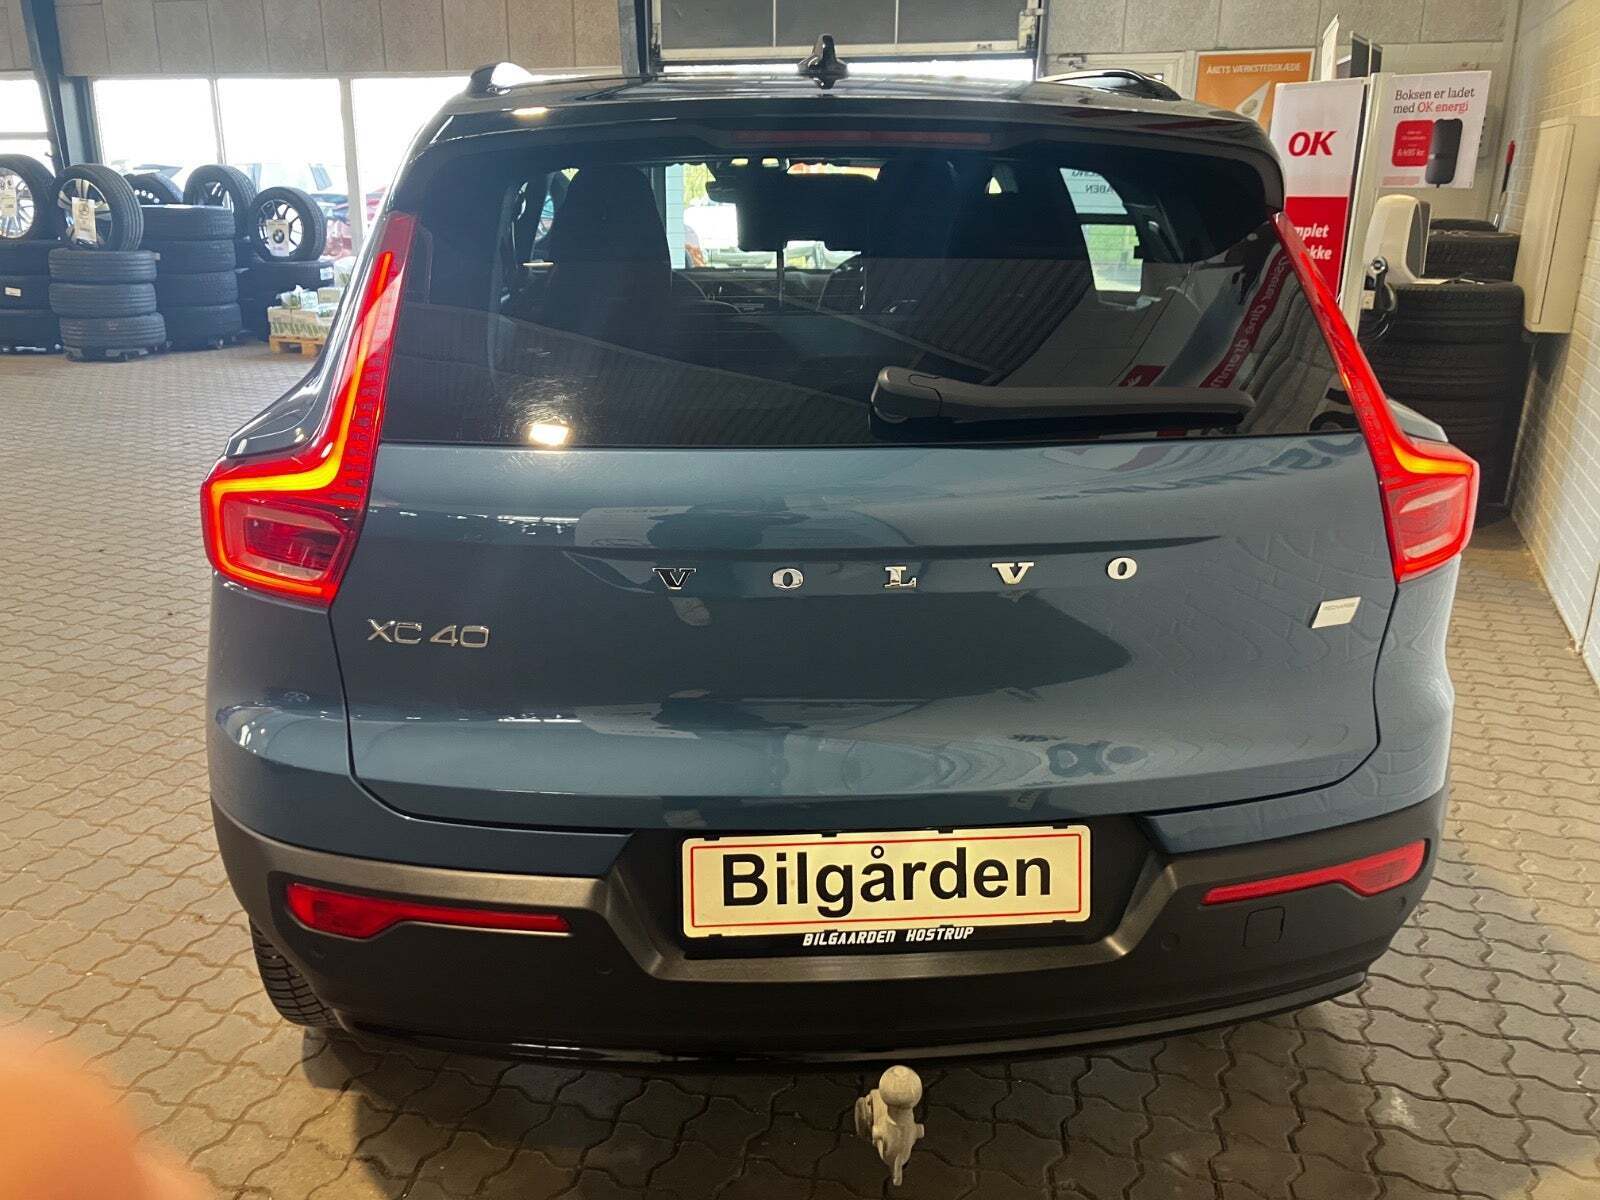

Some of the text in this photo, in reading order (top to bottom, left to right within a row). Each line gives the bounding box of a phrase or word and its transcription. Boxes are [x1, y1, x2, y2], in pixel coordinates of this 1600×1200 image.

[1394, 86, 1476, 101] Boksen er ladet
[1393, 100, 1469, 114] med OK energi
[1288, 130, 1338, 157] OK
[1294, 222, 1330, 241] mplet
[652, 557, 1138, 590] VOLVO
[721, 844, 1051, 918] Bilgården
[802, 926, 974, 946] BILGAARDEN HOSTRUP
